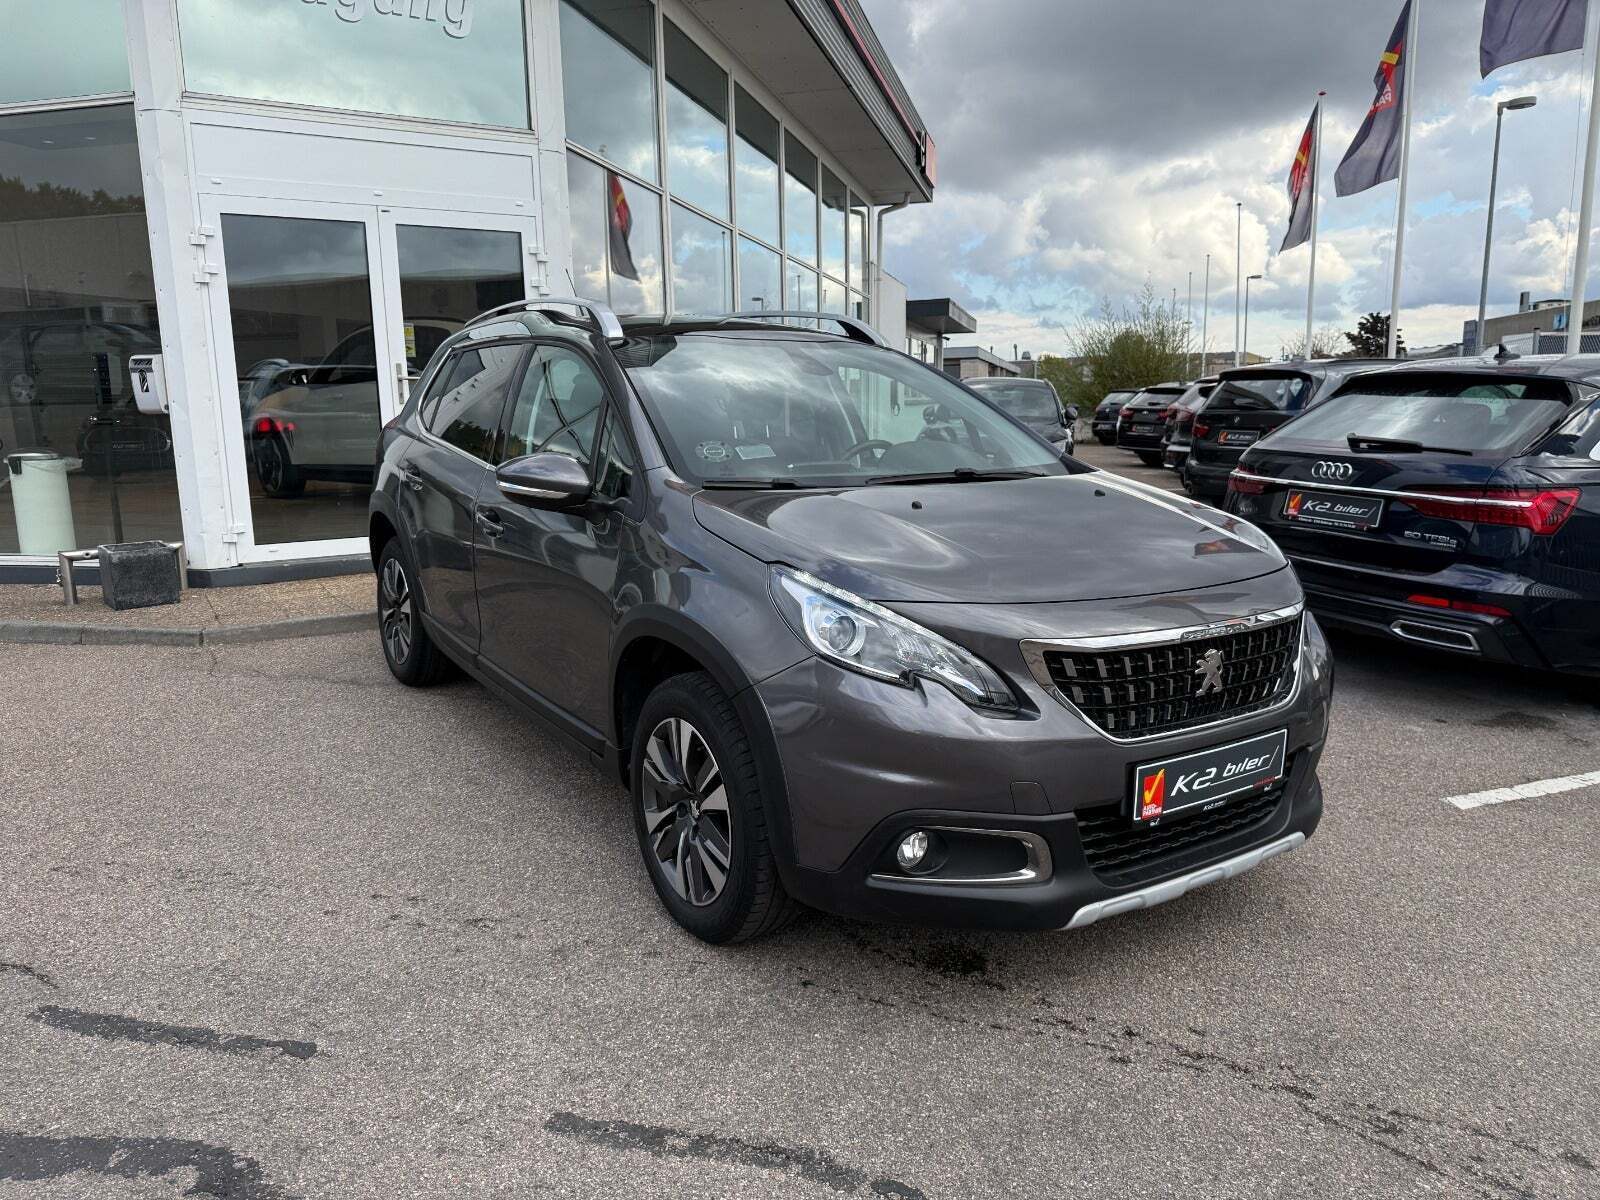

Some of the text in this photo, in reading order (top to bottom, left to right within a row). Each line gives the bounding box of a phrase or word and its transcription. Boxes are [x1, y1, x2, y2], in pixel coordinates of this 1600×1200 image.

[1302, 499, 1369, 515] K2 biler
[1170, 754, 1271, 797] K2 biler
